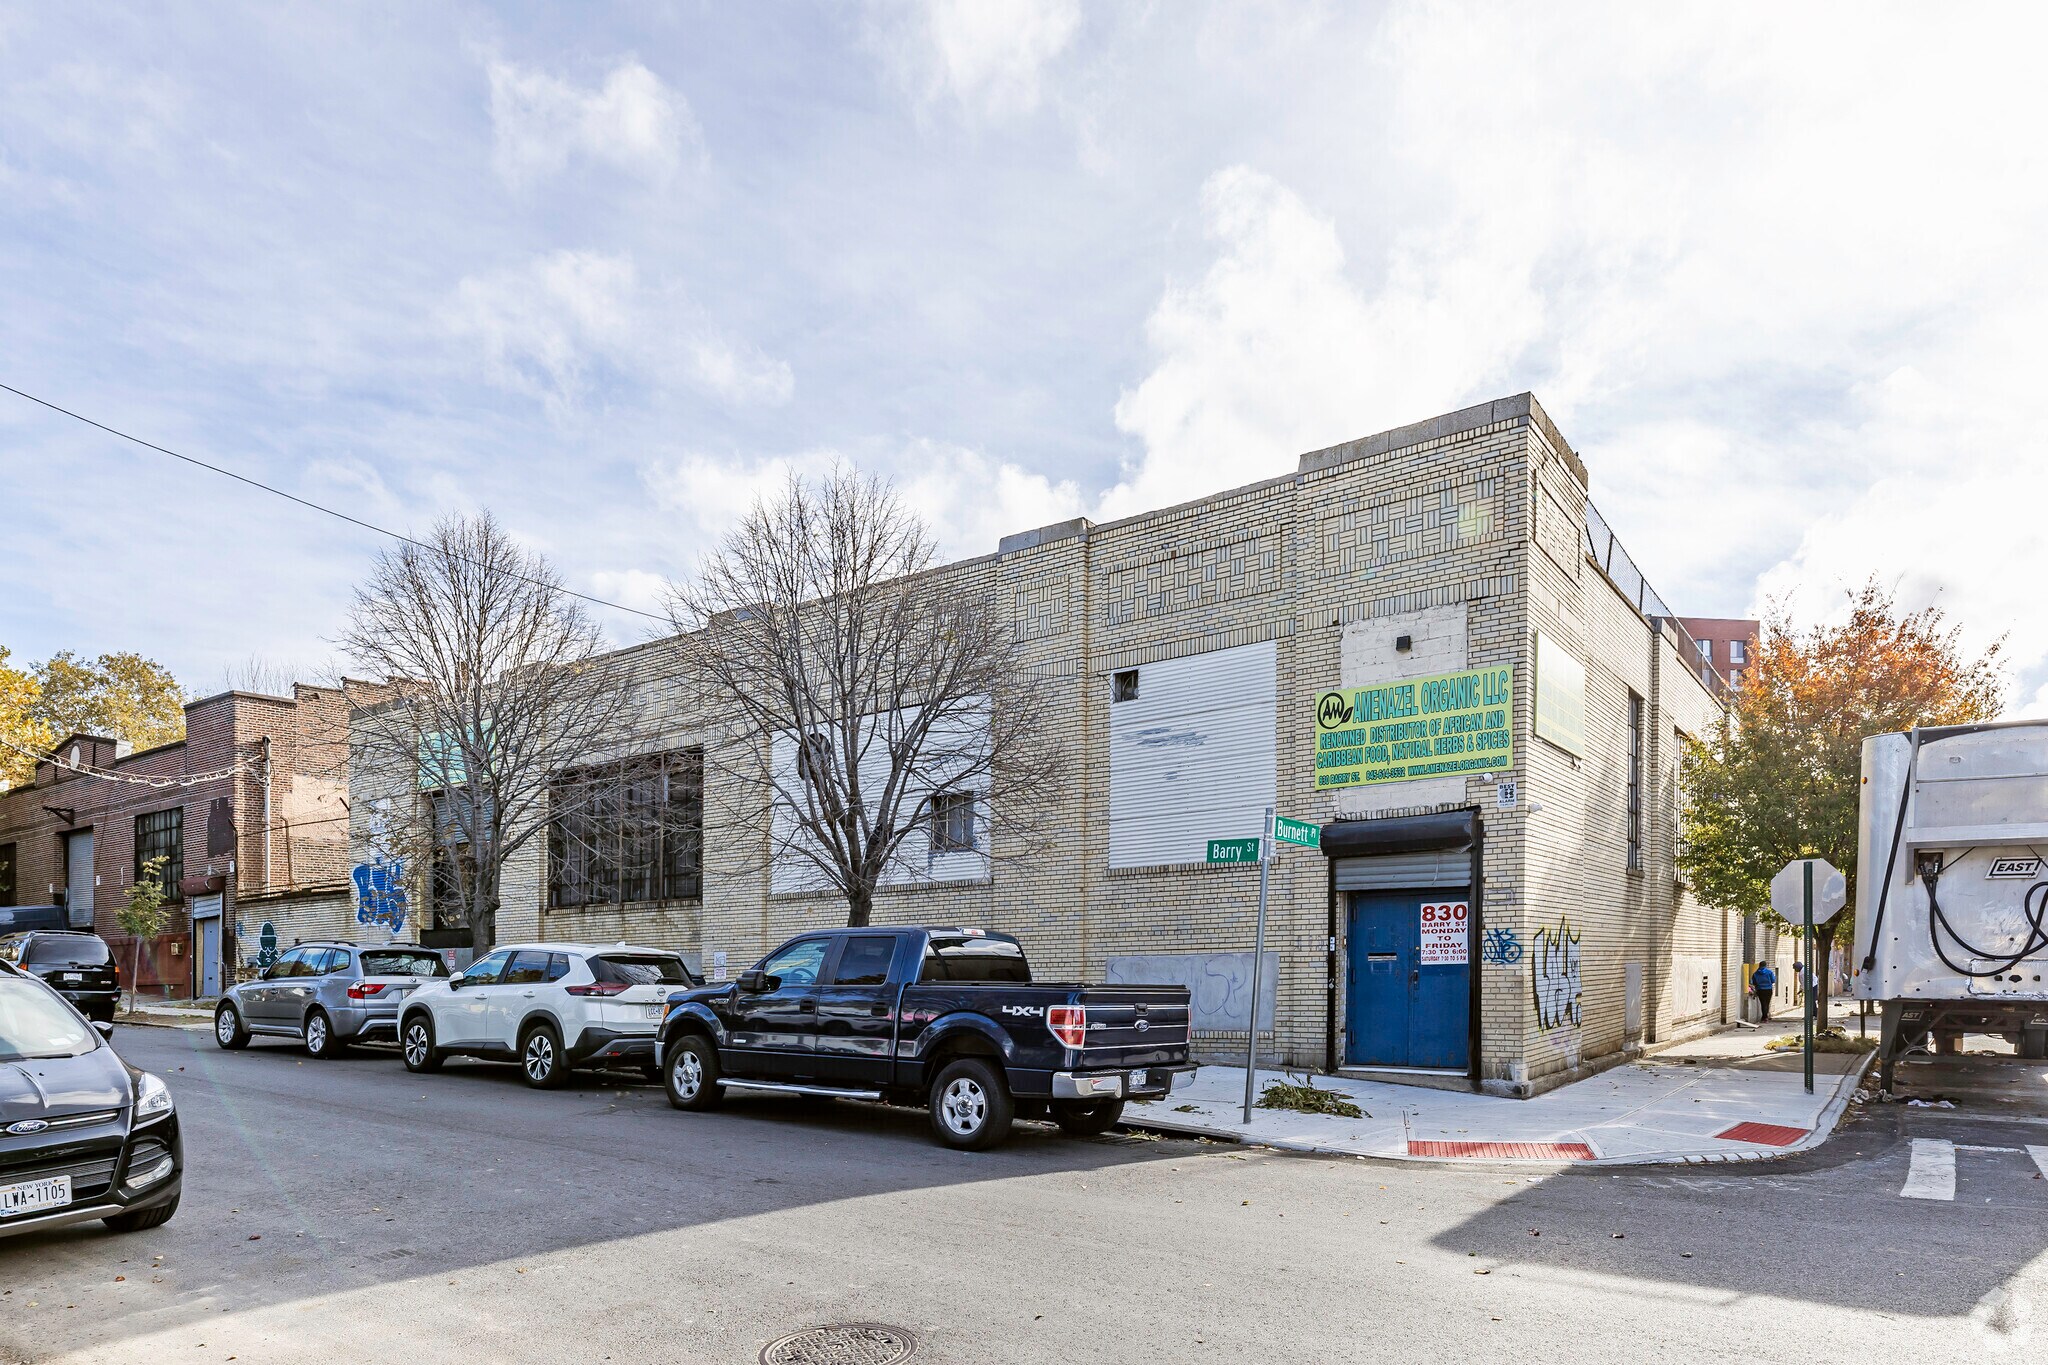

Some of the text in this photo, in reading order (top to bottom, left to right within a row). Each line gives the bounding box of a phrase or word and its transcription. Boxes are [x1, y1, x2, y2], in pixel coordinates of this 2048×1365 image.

[1353, 670, 1508, 723] AMENAZEL ORGANIC LLC
[1320, 710, 1505, 750] RENOWNED DISTRIBUTOR OF AFRICAN AND
[1316, 729, 1509, 769] CARIBBEAN FOOD, NATURAL HERBS & SPICES
[1330, 772, 1351, 784] BARRY
[1408, 756, 1507, 776] WWW.AMENAZELORGANIC.COM
[1277, 819, 1309, 842] Burnett
[1213, 842, 1255, 861] Barry St
[1996, 862, 2035, 872] EAST
[1422, 904, 1468, 921] 830
[1002, 1005, 1044, 1017] 4X4
[17, 1122, 40, 1131] Ford
[34, 1180, 53, 1188] YORK
